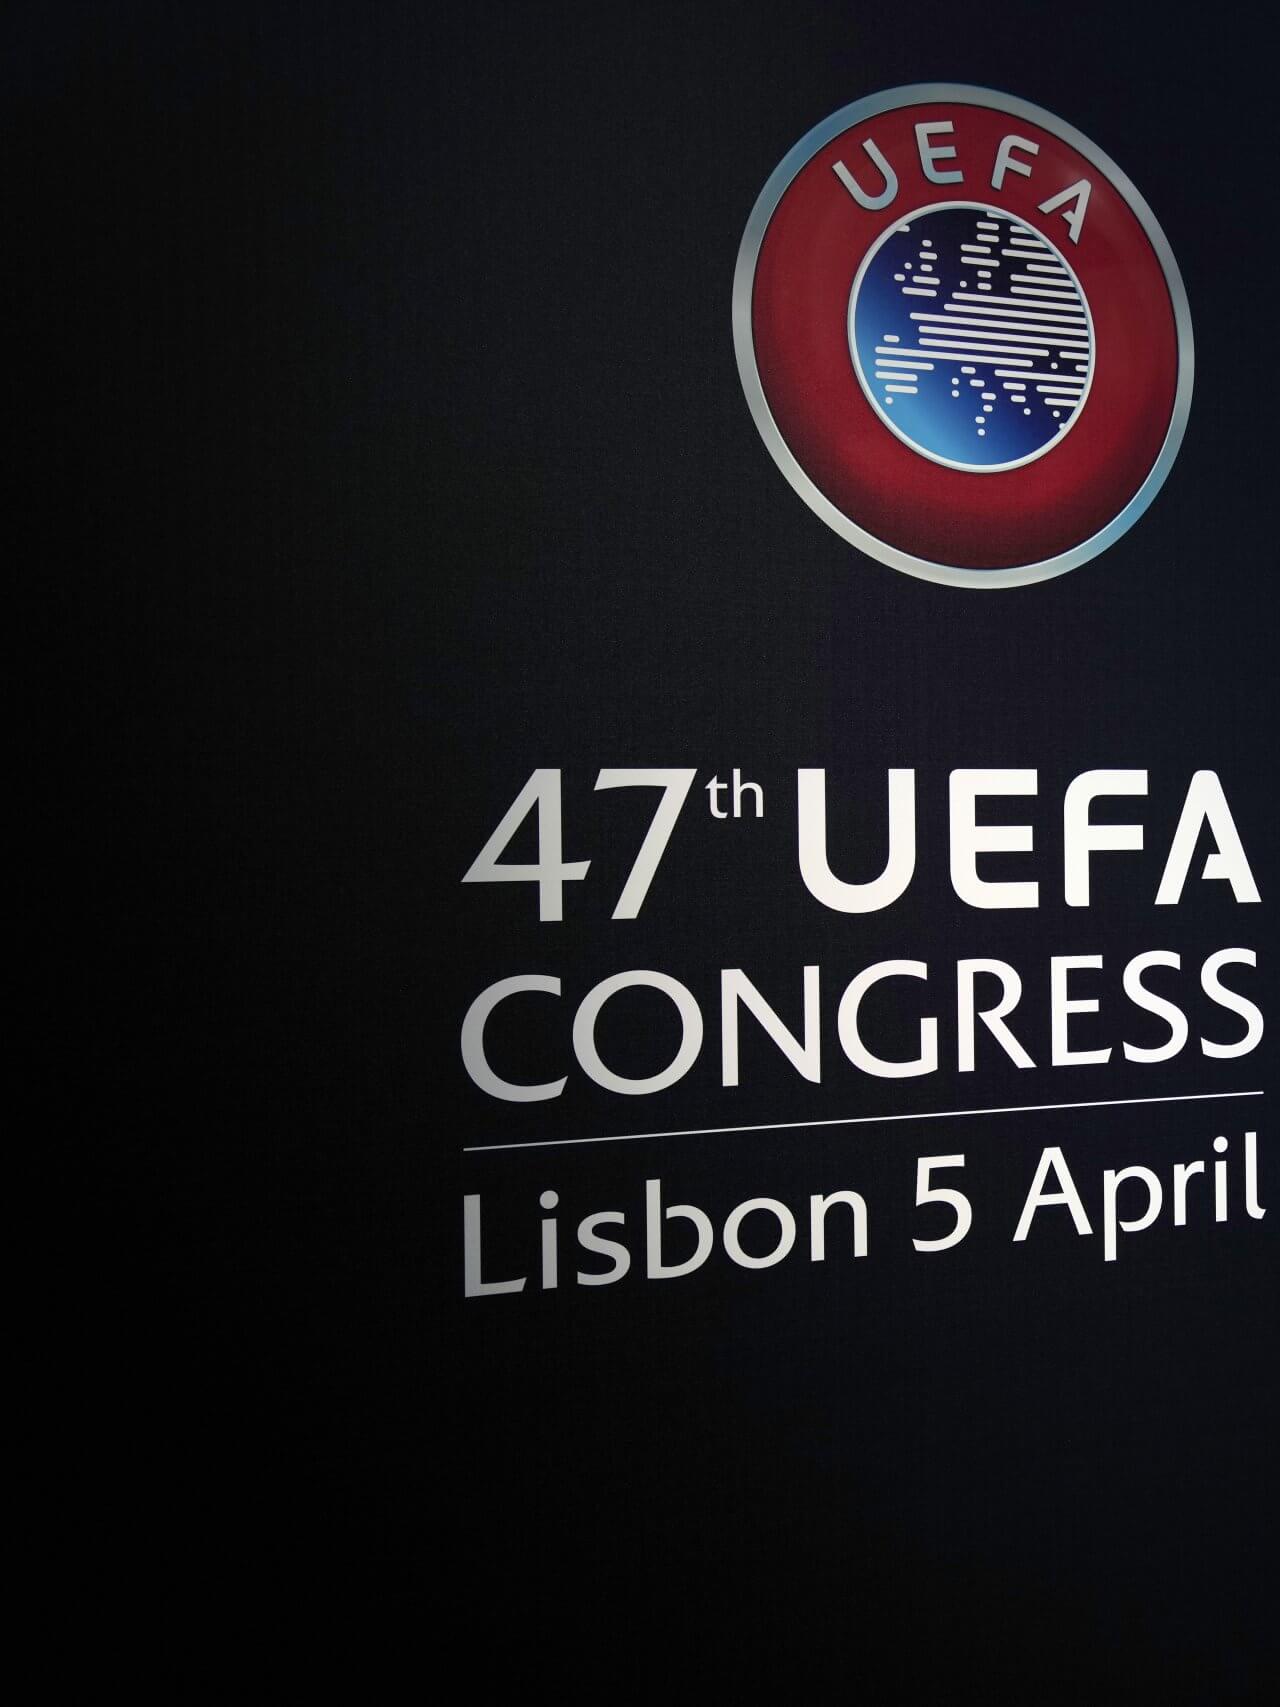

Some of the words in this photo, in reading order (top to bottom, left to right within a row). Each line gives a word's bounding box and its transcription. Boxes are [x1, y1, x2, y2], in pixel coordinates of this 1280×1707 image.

[831, 120, 1093, 245] UEFA
[796, 767, 1263, 914] UEFA
[460, 947, 1266, 1104] CONGRESS
[463, 1178, 868, 1299] Lisbon
[911, 1153, 974, 1254] 5
[1012, 1131, 1267, 1262] April
